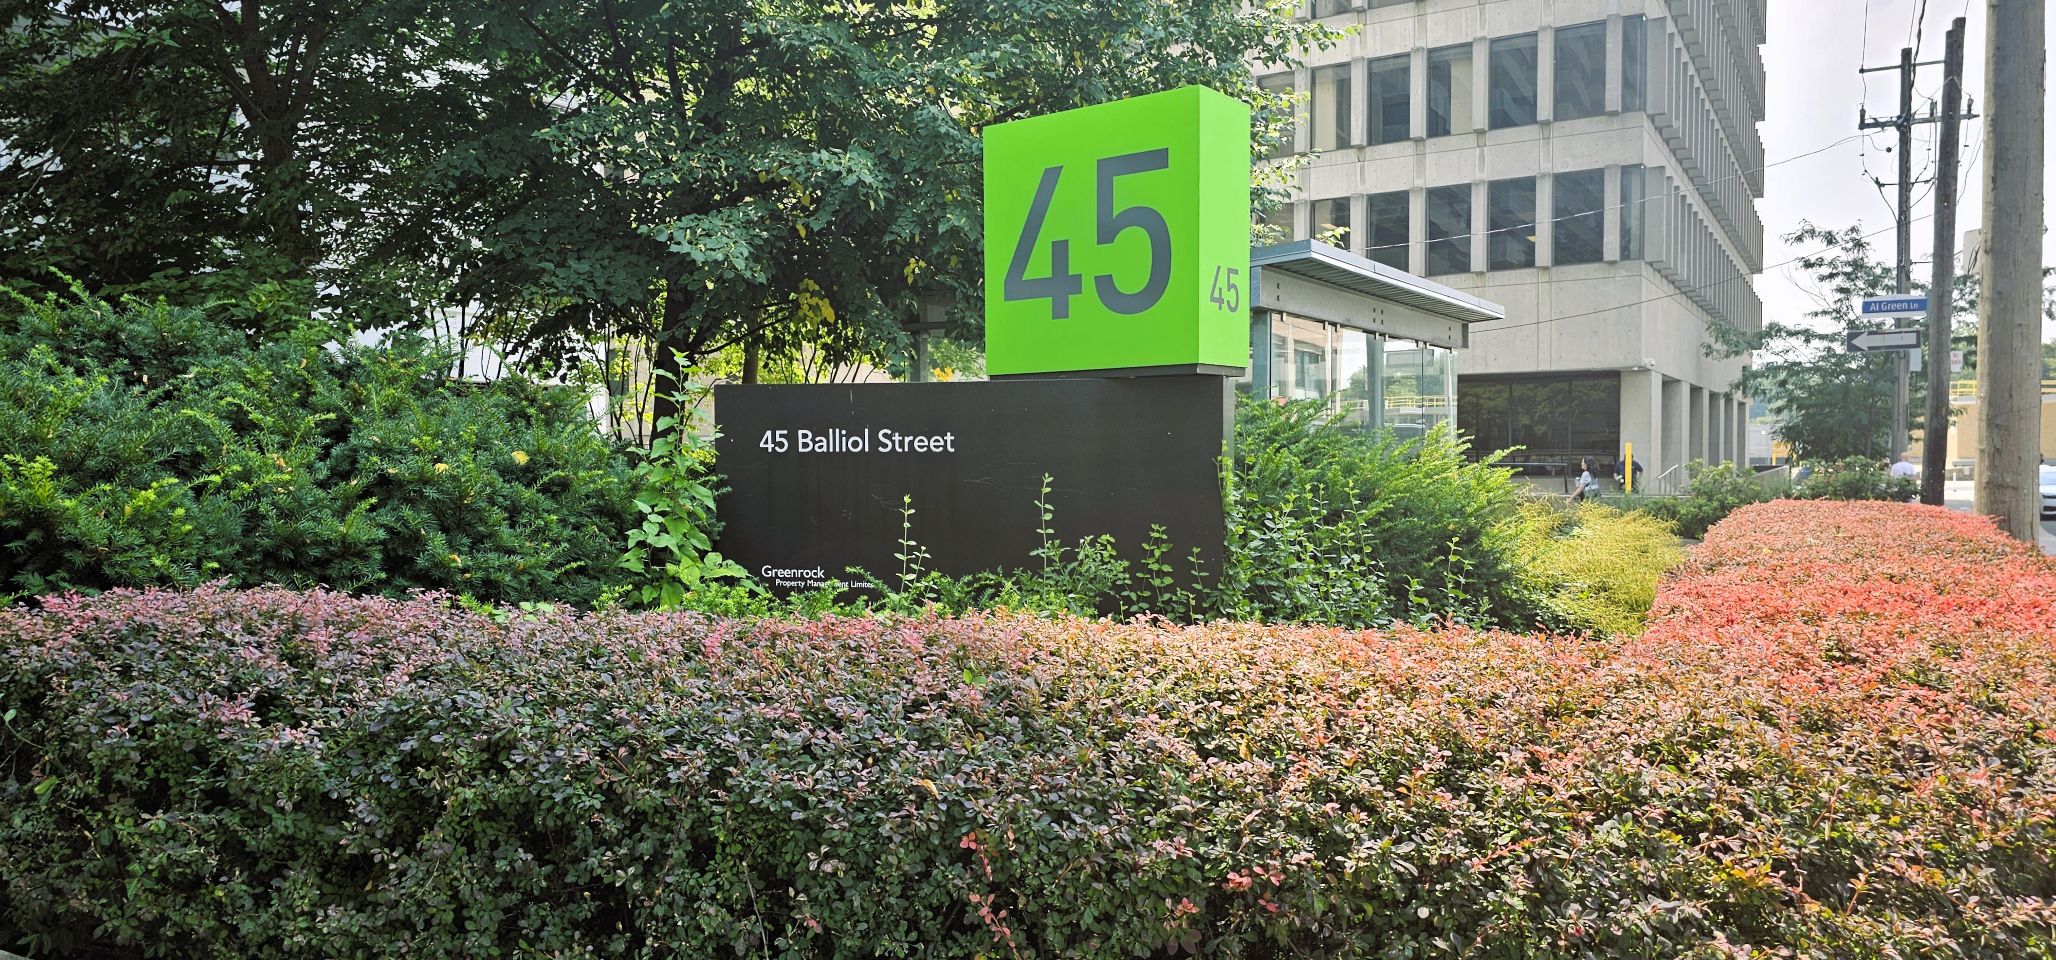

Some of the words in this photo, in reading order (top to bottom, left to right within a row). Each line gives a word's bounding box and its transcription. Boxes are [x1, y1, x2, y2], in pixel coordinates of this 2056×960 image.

[1003, 147, 1172, 320] 45
[1209, 265, 1240, 313] 45
[1870, 302, 1879, 311] Al
[1881, 302, 1908, 311] Green
[759, 430, 789, 452] 45
[798, 428, 869, 452] Balliol
[878, 429, 955, 452] Street
[761, 565, 825, 579] Greenrock
[775, 579, 805, 588] Property
[850, 580, 875, 588] Limite
